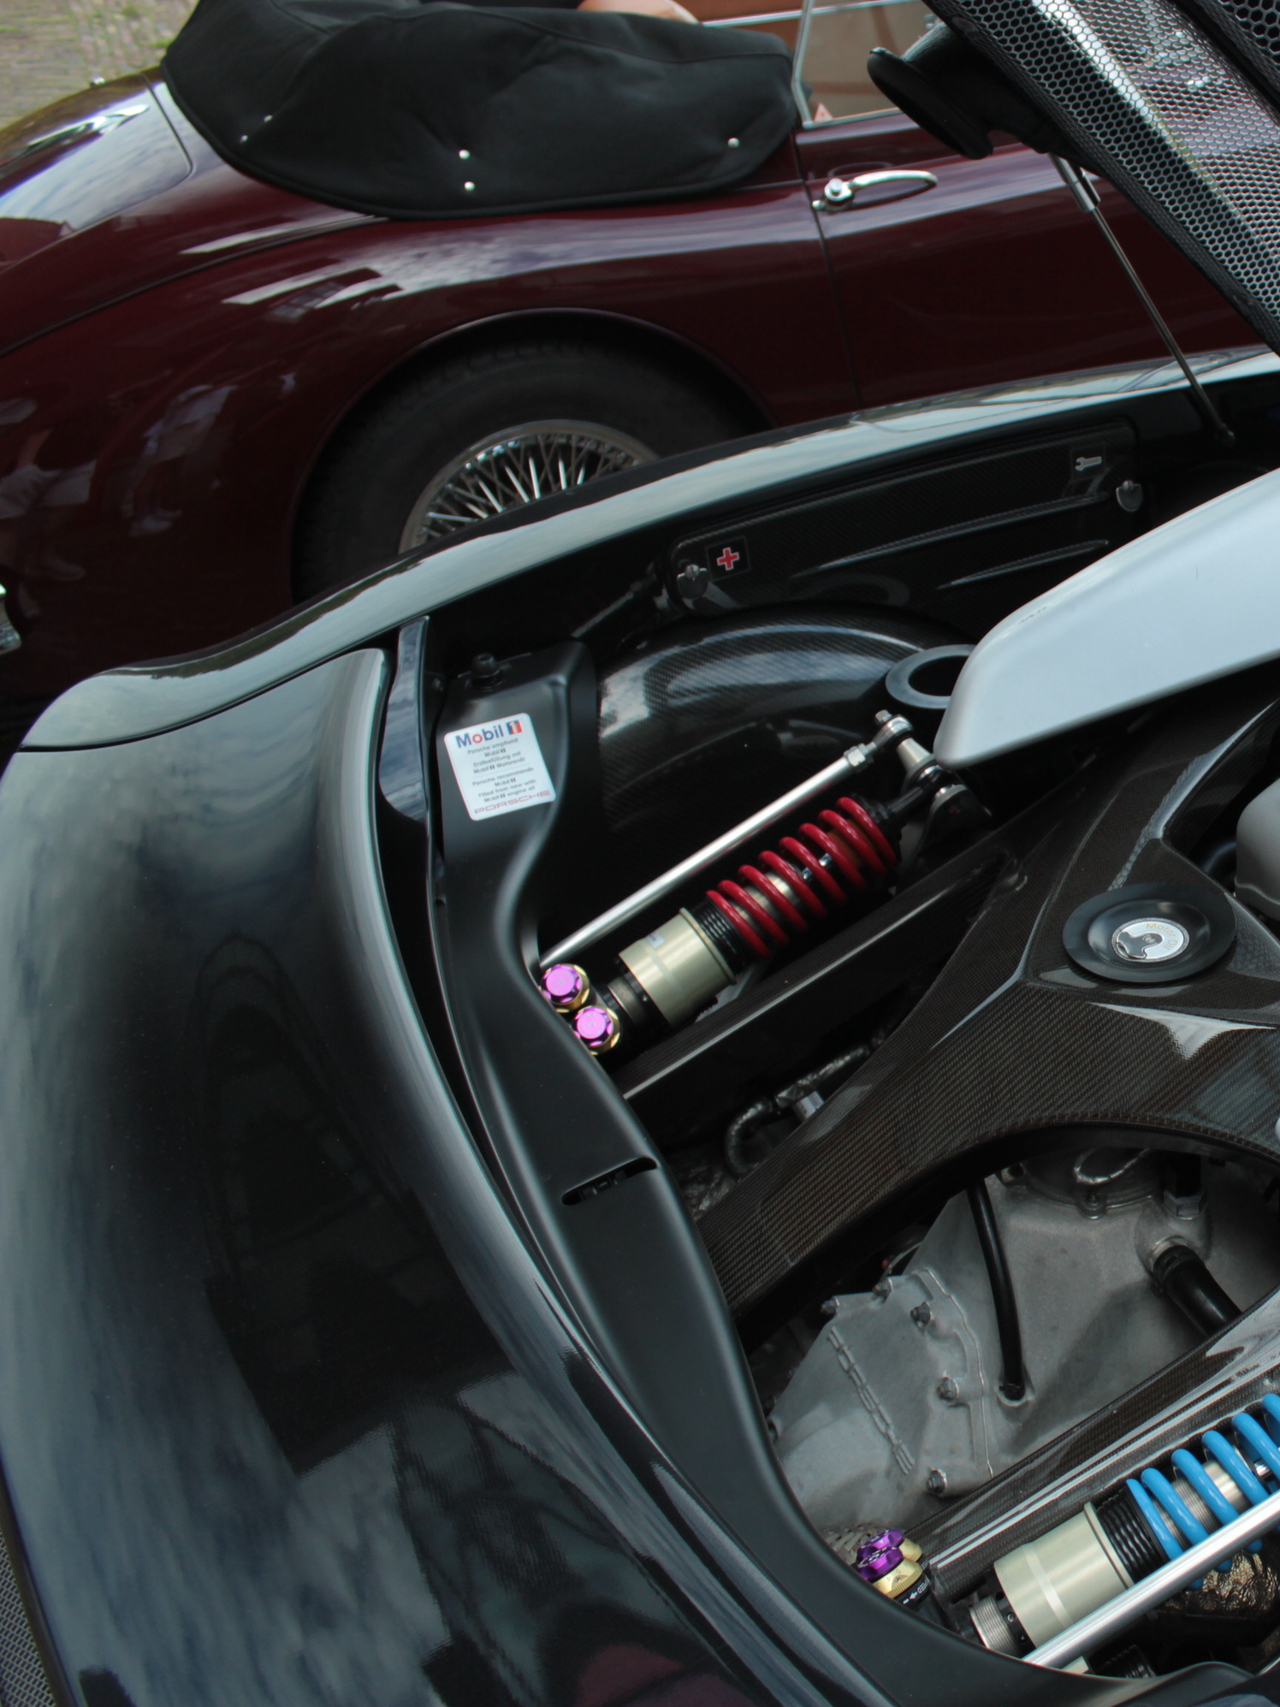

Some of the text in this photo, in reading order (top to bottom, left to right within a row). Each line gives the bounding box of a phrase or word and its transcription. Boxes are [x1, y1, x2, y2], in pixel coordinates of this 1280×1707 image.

[455, 725, 504, 748] Mobil
[467, 746, 490, 755] Porsche
[484, 750, 500, 758] Mobil
[472, 768, 534, 786] Porsche recommends
[473, 766, 490, 774] Mobil
[478, 790, 494, 798] Filled
[484, 795, 500, 803] Mobil
[507, 788, 527, 798] engine
[474, 790, 551, 814] PORSCHE
[1146, 923, 1176, 937] Motor
